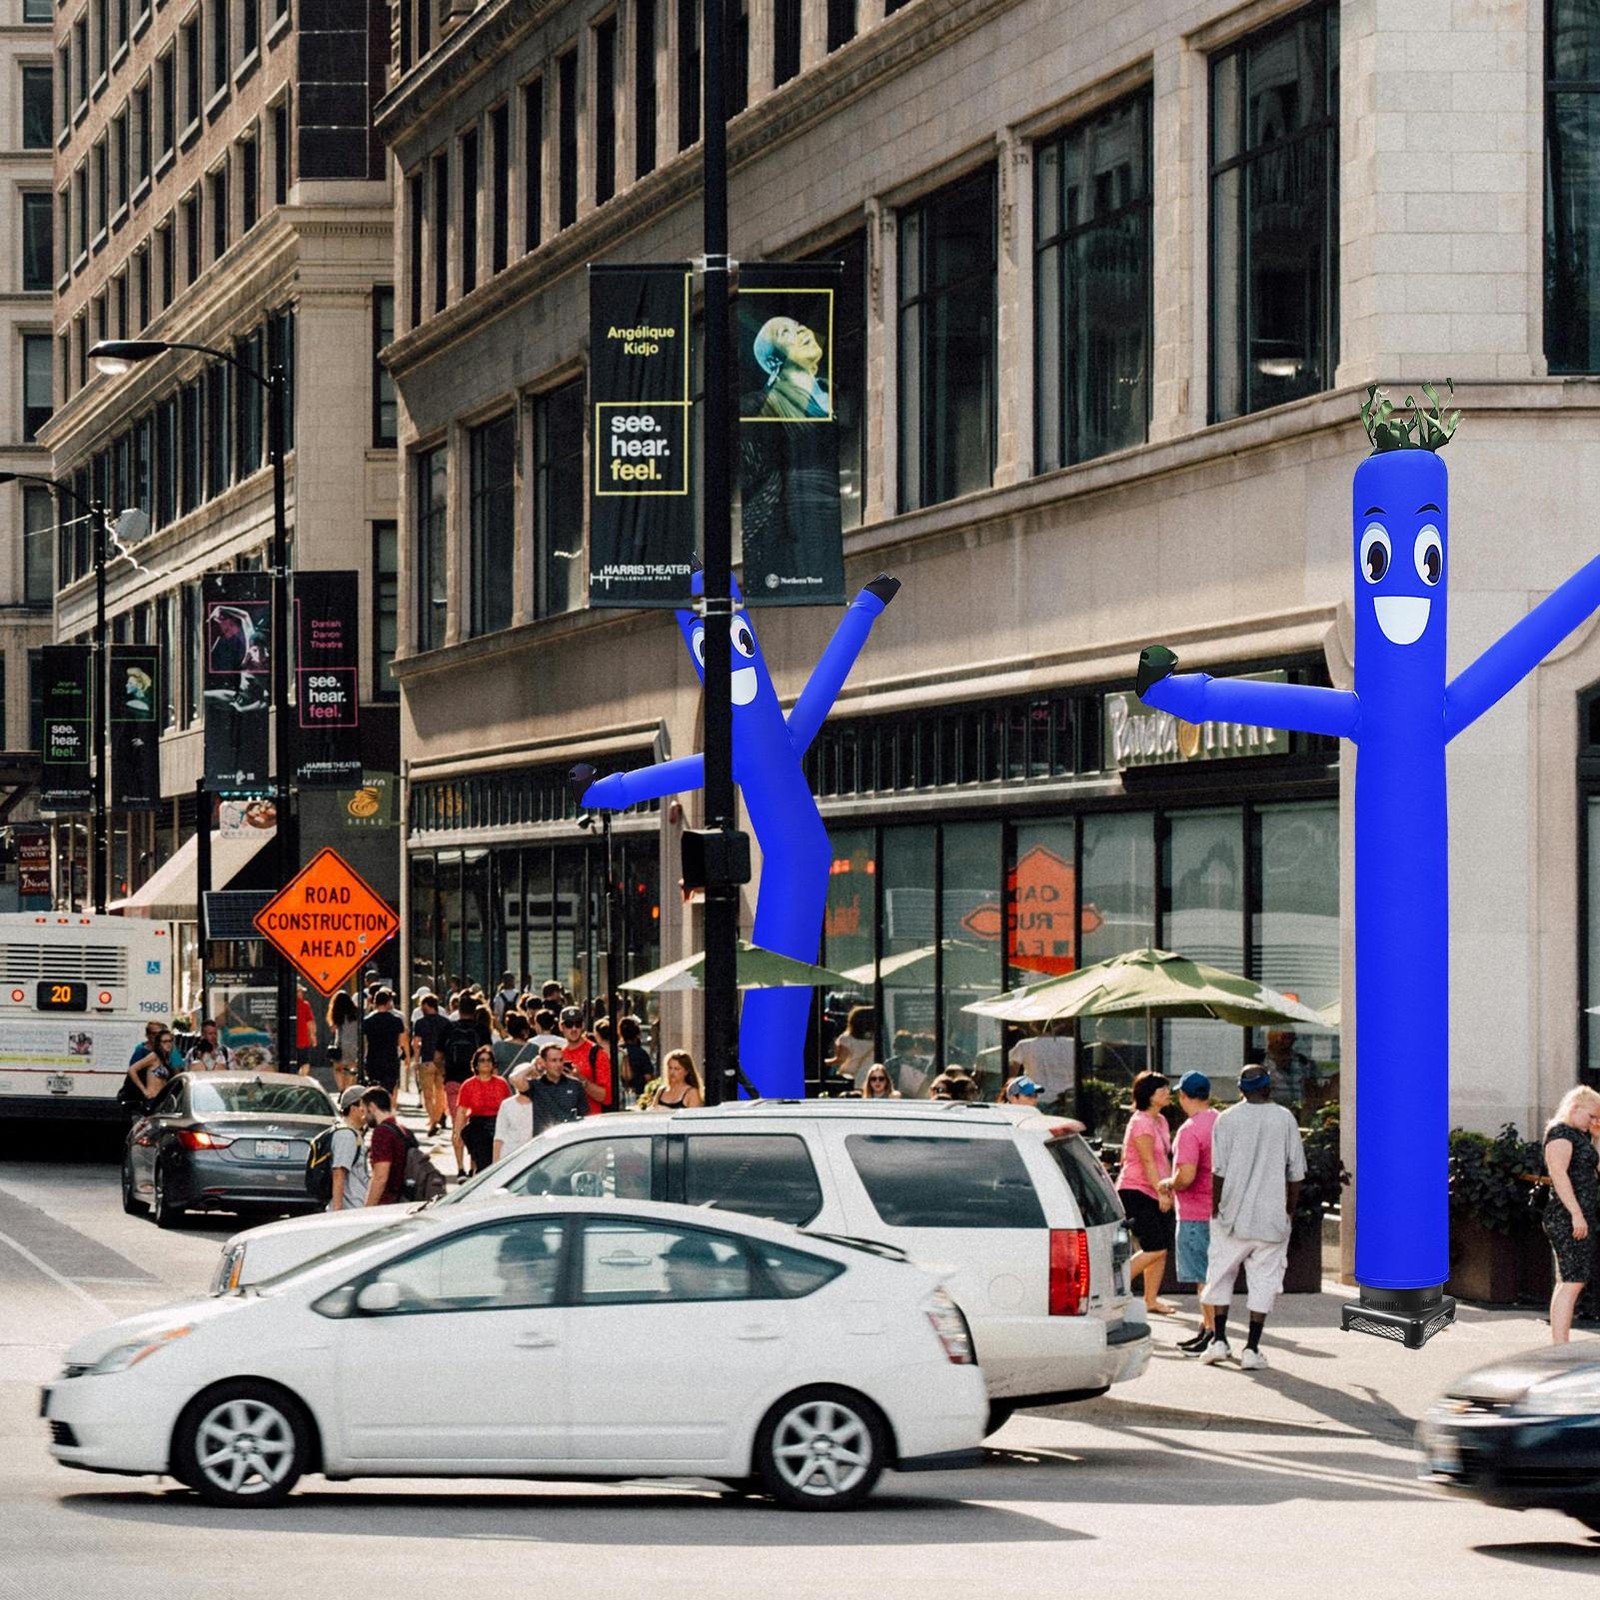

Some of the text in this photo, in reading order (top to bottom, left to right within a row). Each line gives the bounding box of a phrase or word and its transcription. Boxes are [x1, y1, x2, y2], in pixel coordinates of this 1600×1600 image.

[607, 325, 675, 340] Angélique
[623, 342, 659, 357] Kidjo
[611, 415, 662, 433] see.
[611, 435, 670, 457] hear.
[610, 458, 662, 480] feel.
[603, 564, 691, 575] HARRIS THEATER
[308, 676, 341, 688] see.
[308, 689, 347, 703] hear.
[308, 704, 342, 718] feel.
[51, 724, 76, 734] see.
[51, 735, 81, 746] hear.
[51, 746, 76, 757] feel.
[305, 760, 362, 769] HARRIS THEATER
[305, 887, 351, 904] ROAD
[267, 913, 388, 931] CONSTRUCTION
[300, 940, 356, 957] AHEAD
[50, 985, 72, 1003] 20
[138, 1001, 169, 1013] 1986
